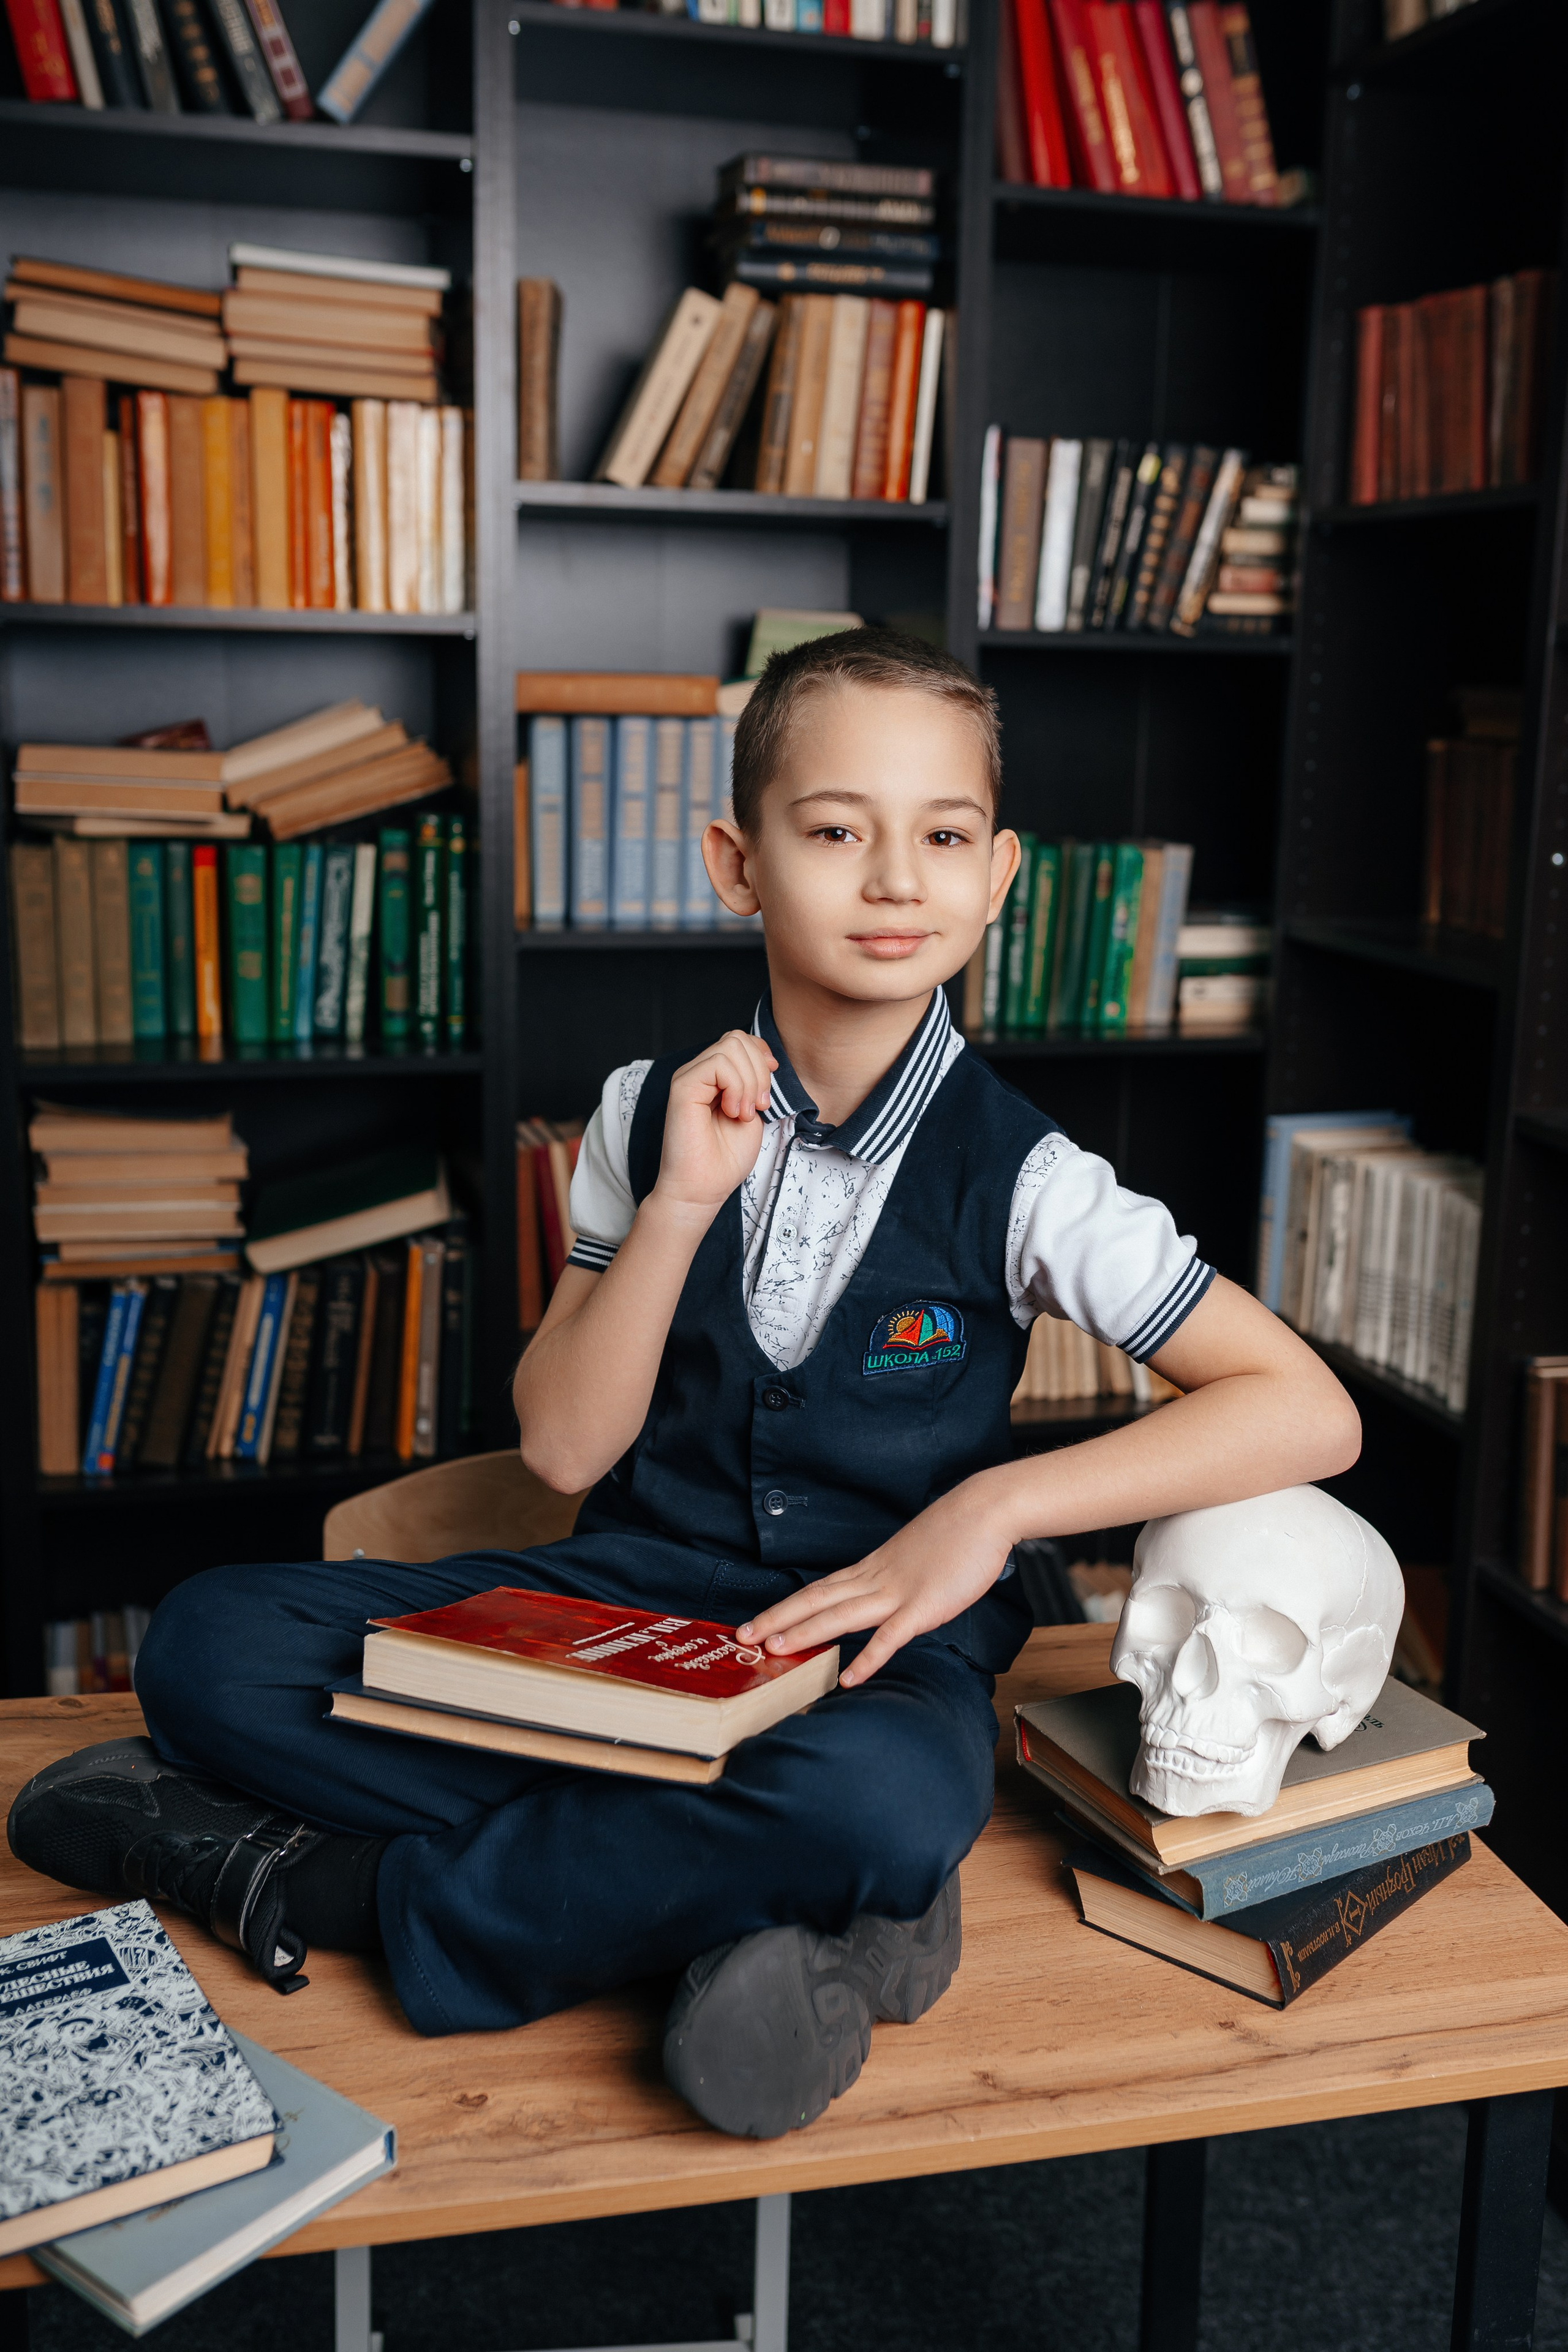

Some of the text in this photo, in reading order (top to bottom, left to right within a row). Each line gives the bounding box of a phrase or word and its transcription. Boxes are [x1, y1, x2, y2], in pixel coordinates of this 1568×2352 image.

[867, 1351, 929, 1368] ШКОЛА
[674, 1634, 766, 1670] Рассказы
[16, 1951, 67, 1970] СВИФТ
[0, 1961, 90, 1994] ДЕСНЫЕ
